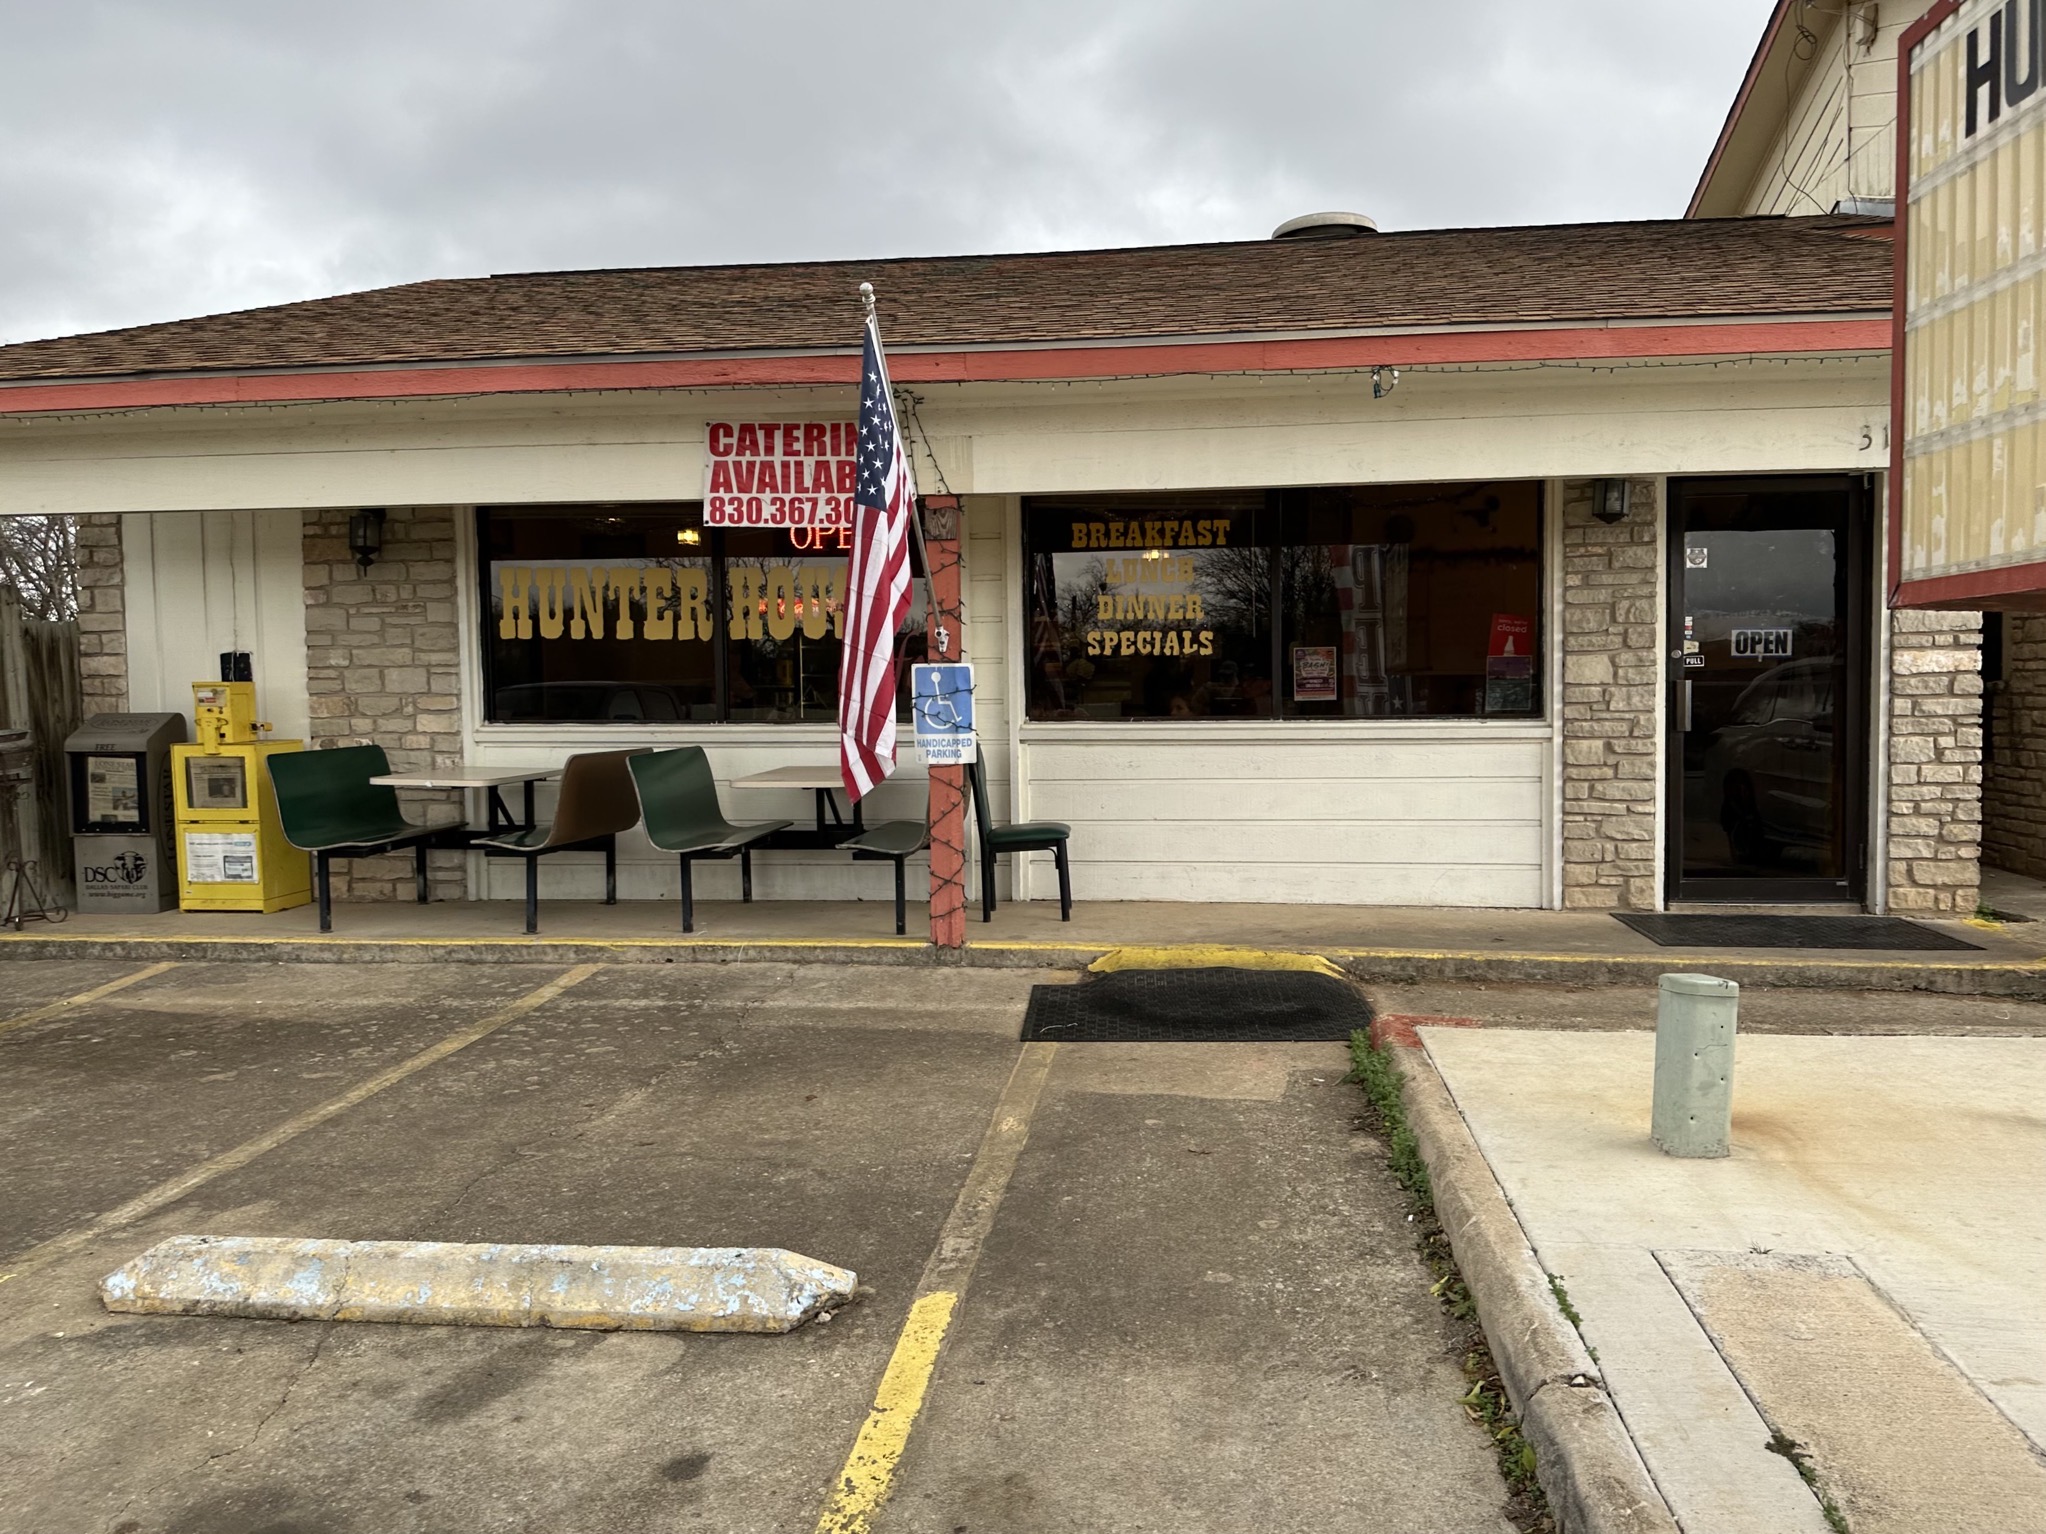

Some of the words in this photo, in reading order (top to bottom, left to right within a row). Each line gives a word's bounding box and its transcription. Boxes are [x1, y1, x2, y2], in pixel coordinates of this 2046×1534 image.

[1965, 0, 2046, 139] HU
[1071, 520, 1231, 548] BREAKFAST
[1106, 557, 1195, 583] LUNCH
[499, 567, 714, 641] HUNTER
[1097, 595, 1205, 620] DINNER
[1497, 624, 1527, 633] closed
[1087, 631, 1214, 656] SPECIALS
[1735, 631, 1788, 654] OPEN
[1686, 656, 1702, 665] PULL
[916, 738, 972, 748] HANDICAPPED
[926, 749, 962, 758] PARKING
[84, 867, 117, 883] DSC
